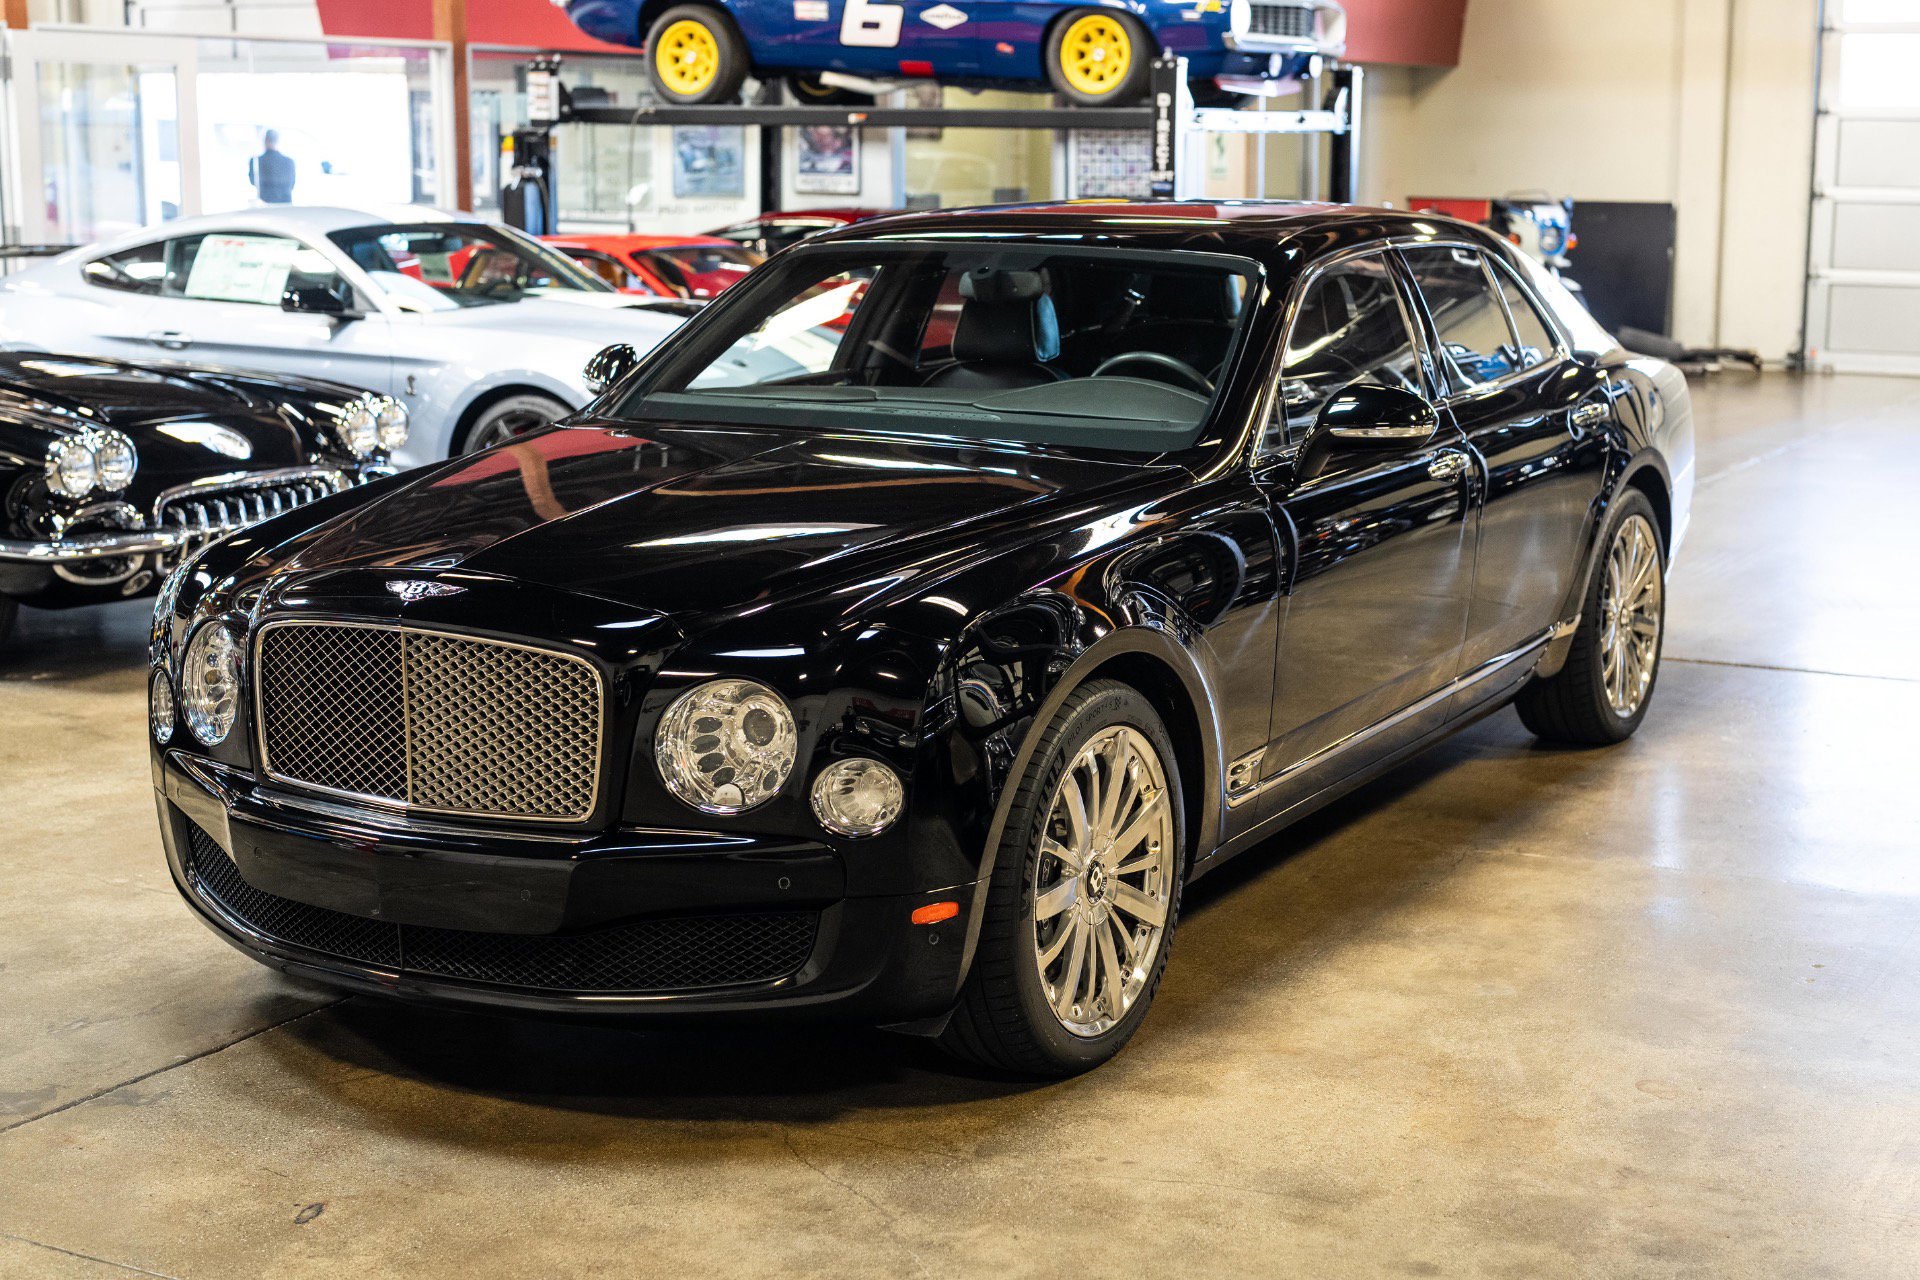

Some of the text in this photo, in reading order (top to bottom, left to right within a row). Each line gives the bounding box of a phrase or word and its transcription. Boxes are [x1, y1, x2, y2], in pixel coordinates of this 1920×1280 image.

[840, 0, 904, 47] 6
[1156, 92, 1171, 171] DIRECT
[1023, 752, 1064, 884] MICHELIN
